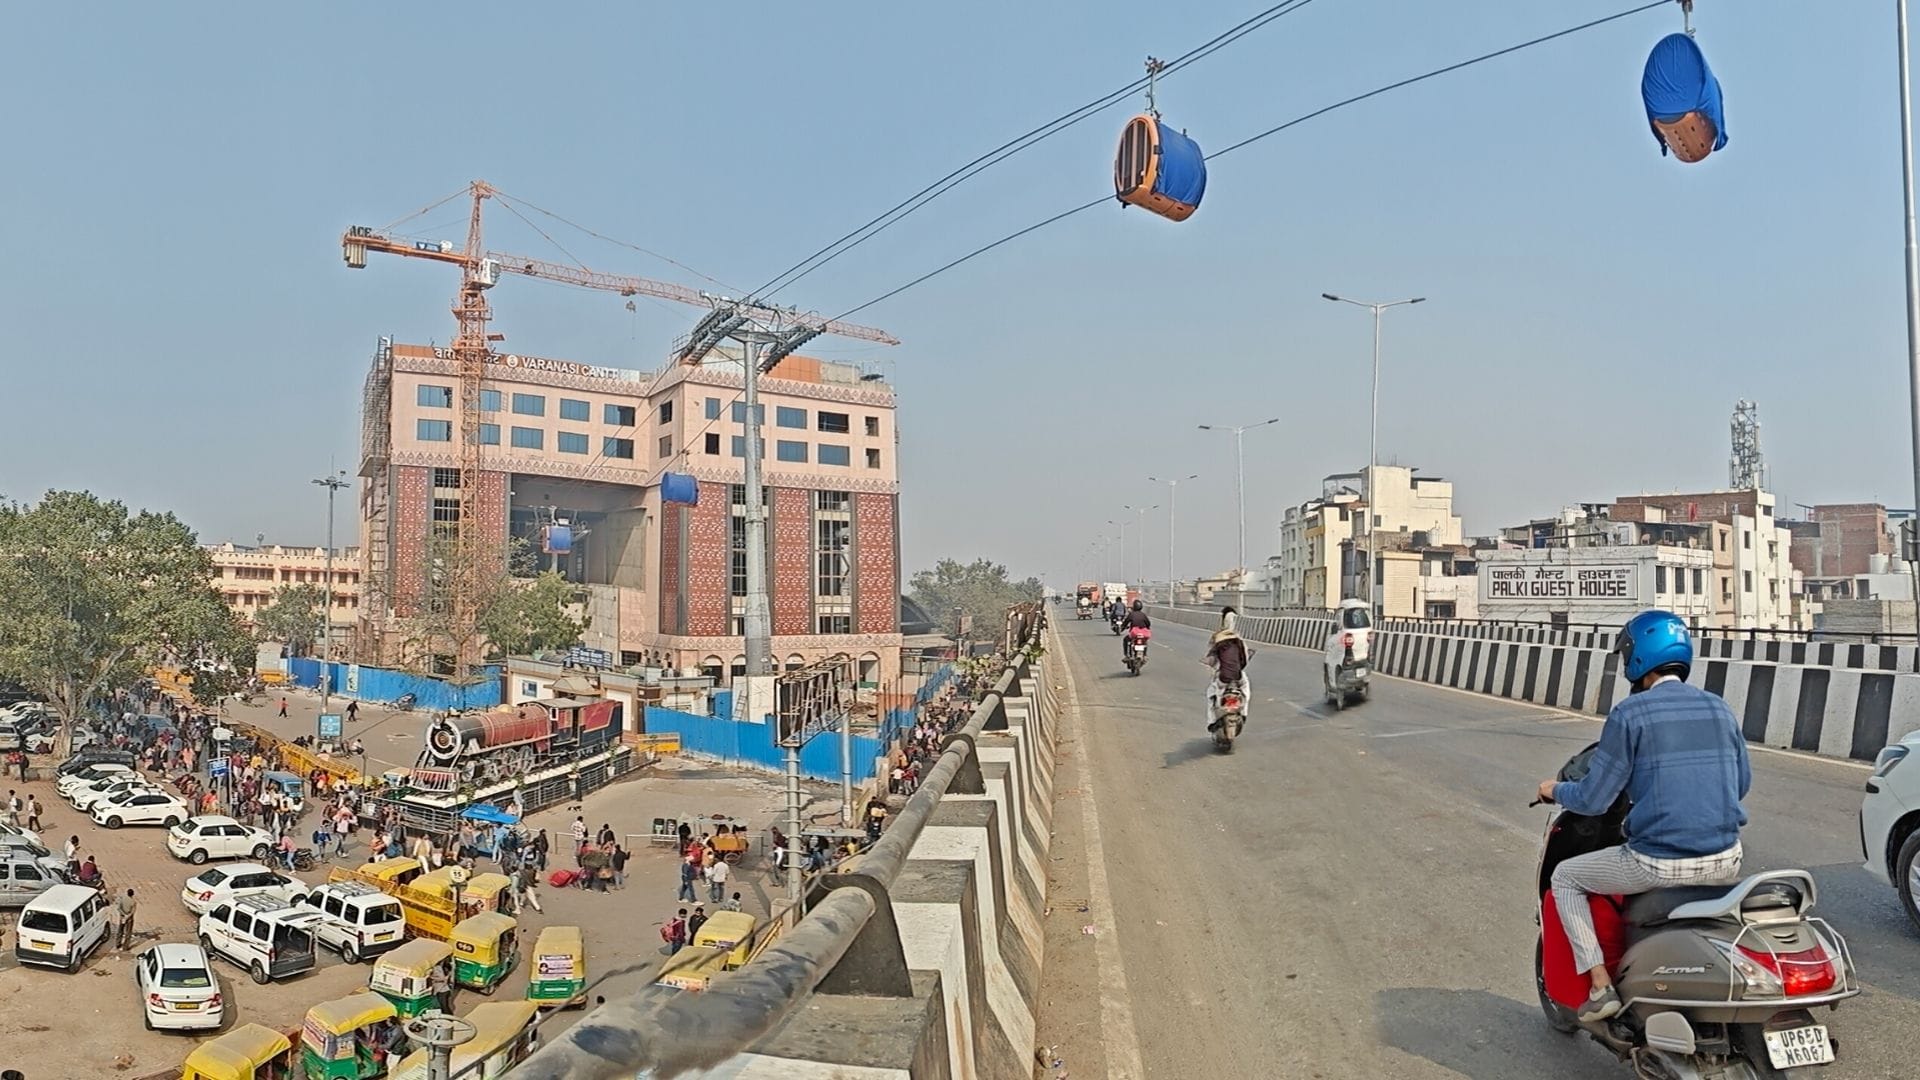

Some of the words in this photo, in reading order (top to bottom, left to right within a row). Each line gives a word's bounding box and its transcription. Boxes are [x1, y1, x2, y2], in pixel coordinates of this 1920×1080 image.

[521, 356, 580, 375] VARANASI
[1492, 567, 1526, 580] पालकी
[1534, 566, 1564, 580] गेस्ट
[1577, 569, 1612, 580] हाउस
[1492, 581, 1528, 596] PALKI
[1531, 581, 1574, 596] GUEST
[1579, 581, 1627, 596] HOUSE
[1780, 1027, 1823, 1047] UP65D
